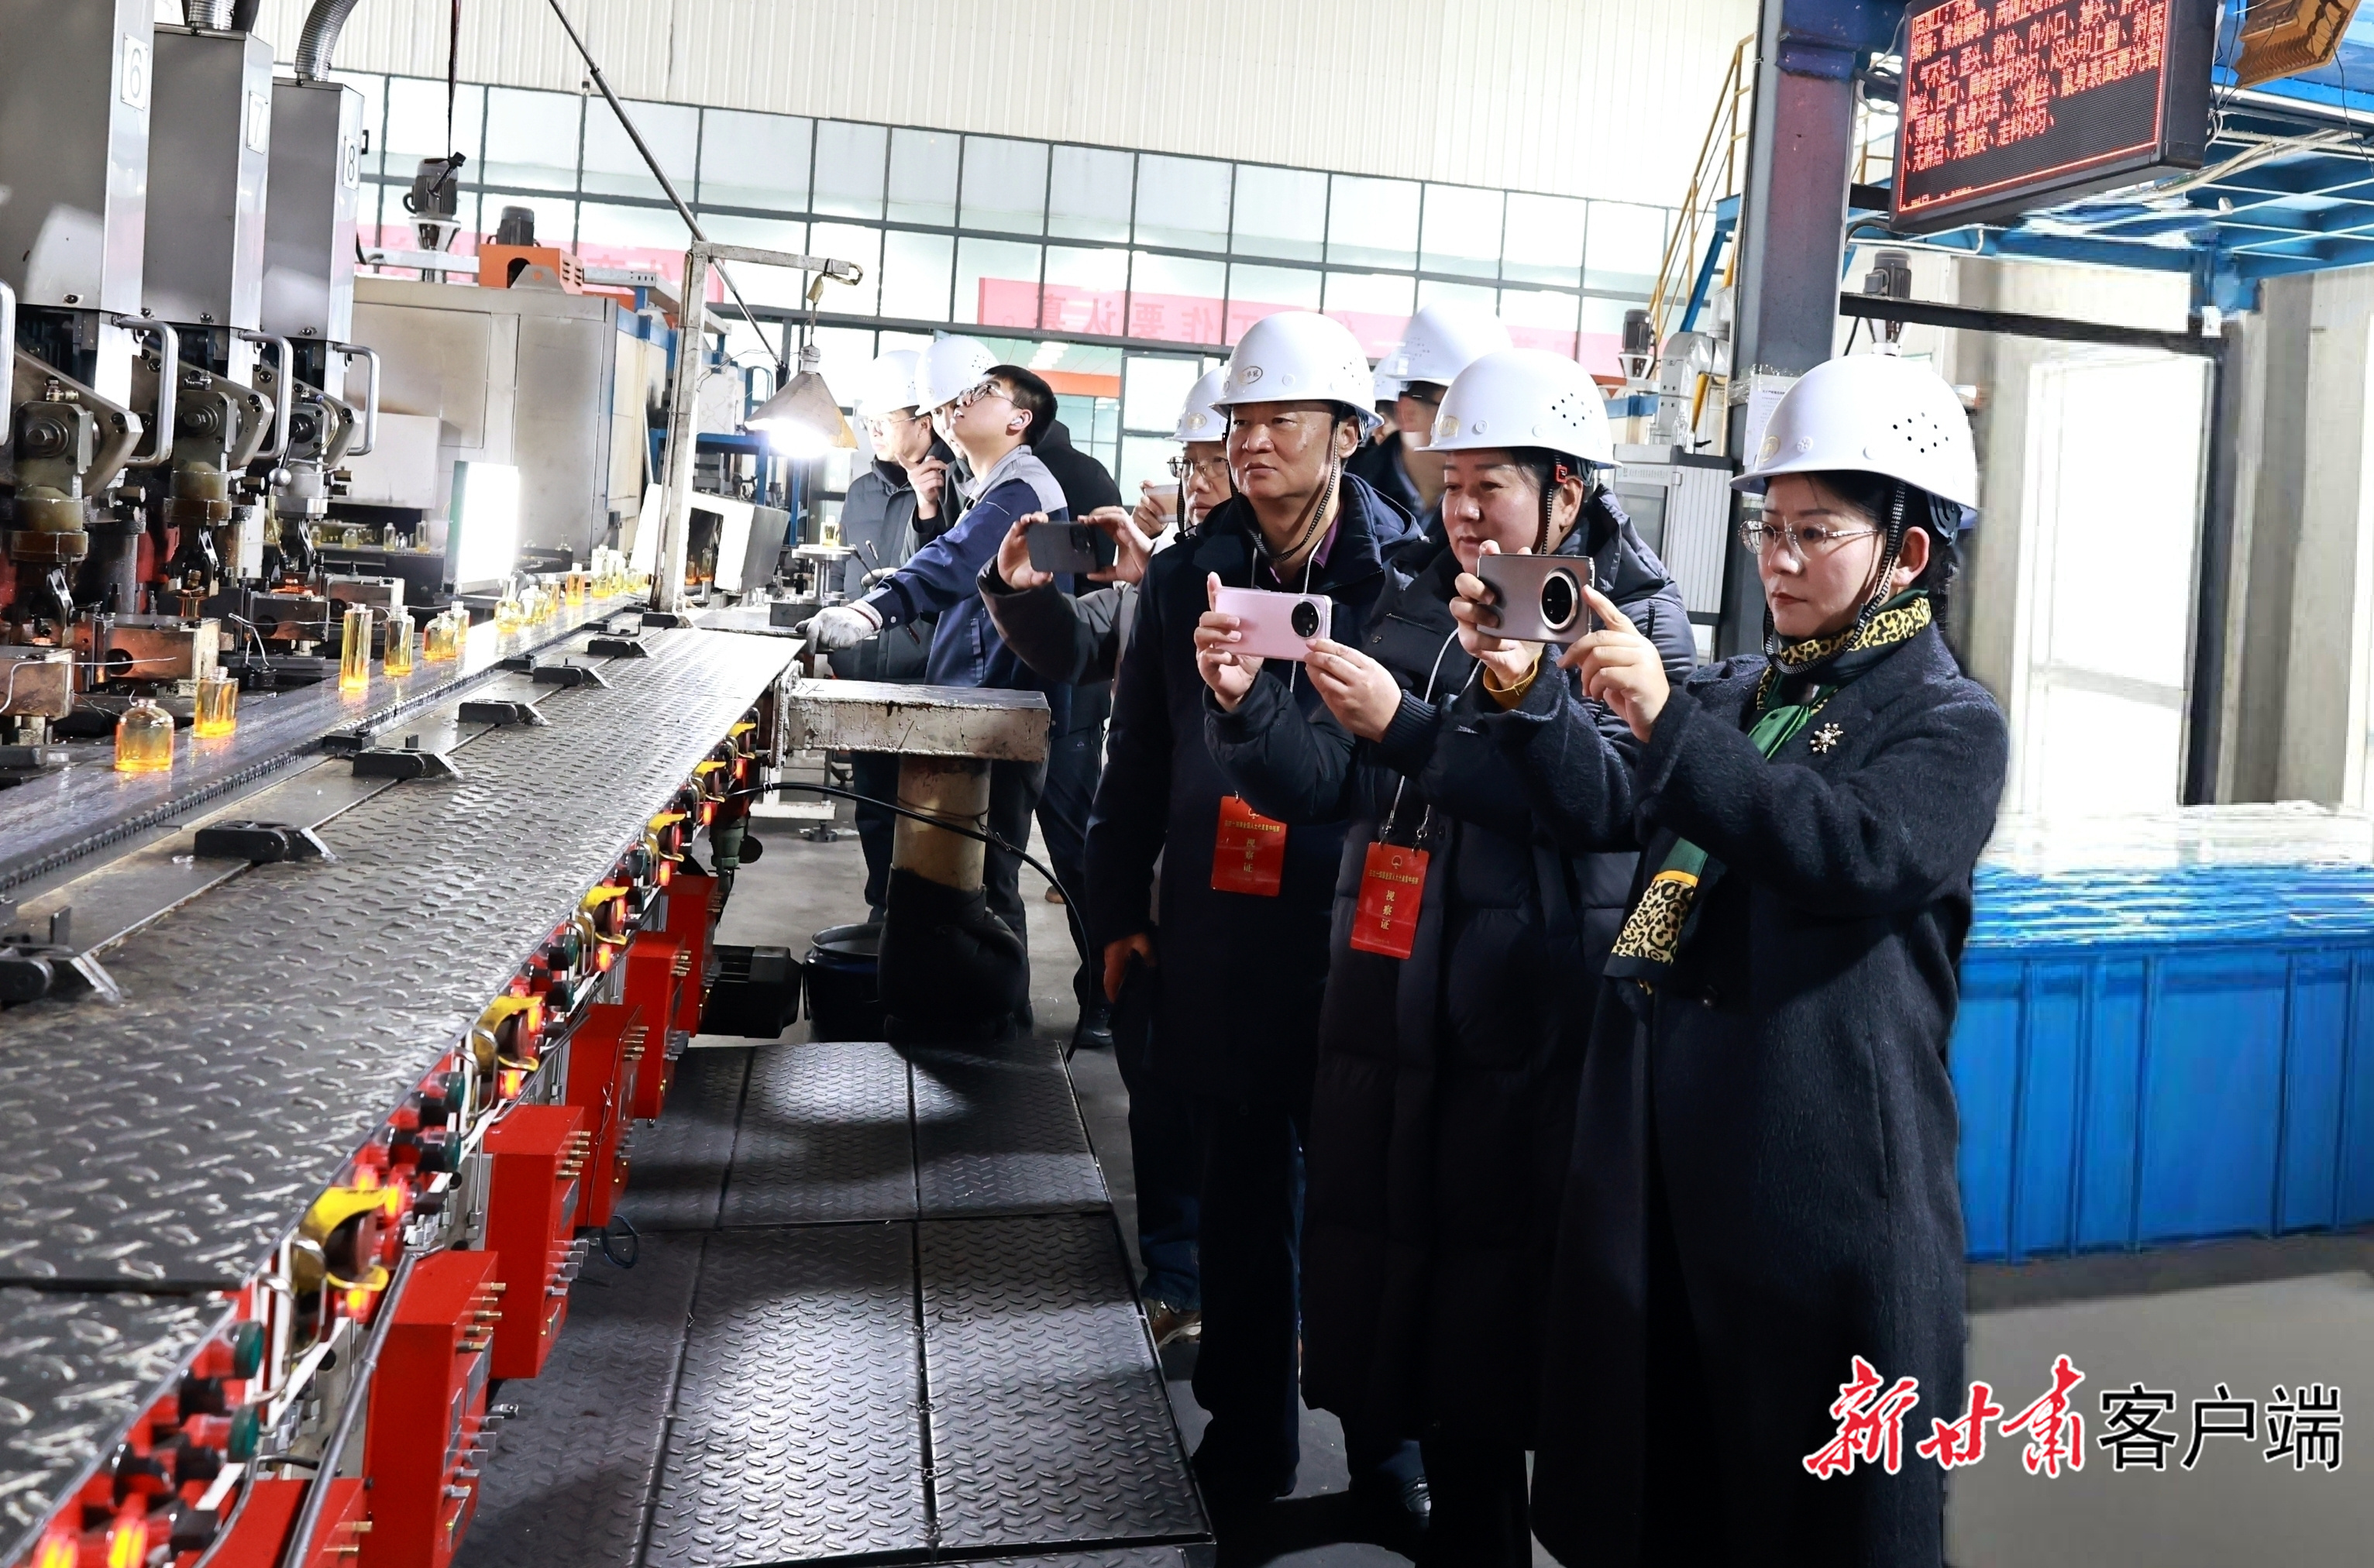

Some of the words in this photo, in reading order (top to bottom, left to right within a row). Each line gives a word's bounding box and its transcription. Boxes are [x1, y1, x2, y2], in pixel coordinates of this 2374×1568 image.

[129, 47, 143, 99] 6
[253, 100, 263, 144] 7
[347, 144, 356, 182] 8
[1243, 837, 1256, 873] 视察证
[1380, 889, 1395, 930] 视察证
